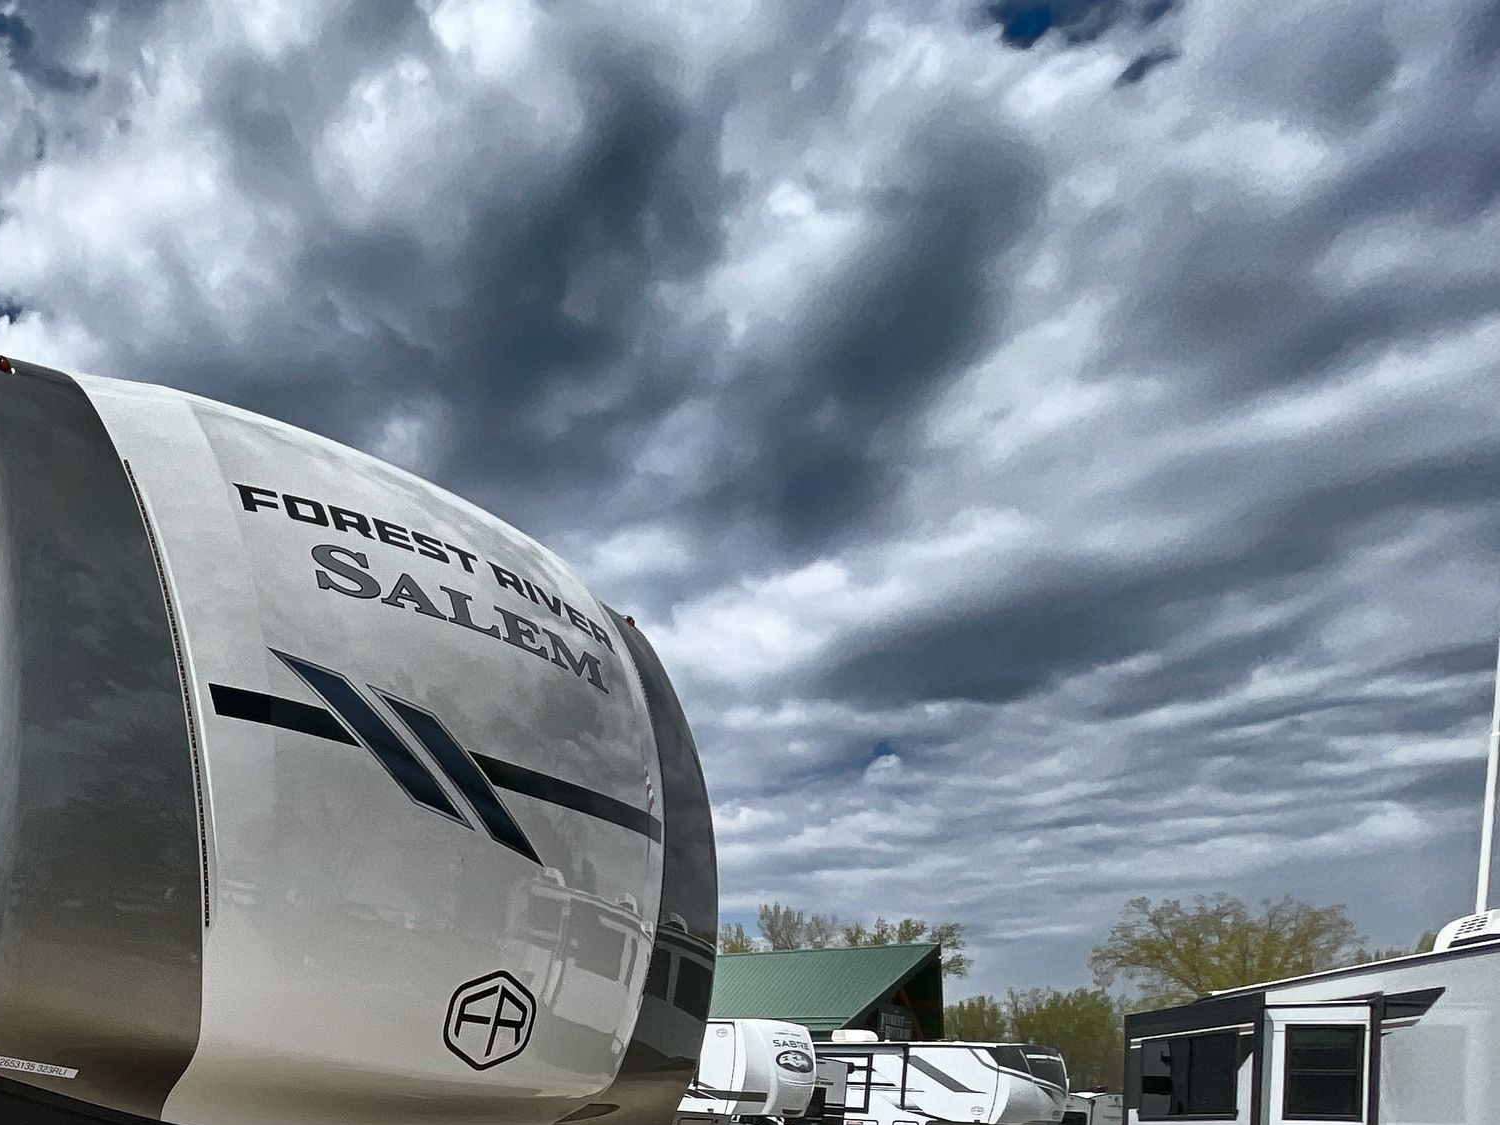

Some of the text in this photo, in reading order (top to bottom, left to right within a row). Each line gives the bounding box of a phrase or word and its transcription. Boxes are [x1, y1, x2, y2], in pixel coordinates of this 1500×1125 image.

[232, 482, 616, 655] FOREST RIVER
[311, 544, 610, 695] SALEM
[773, 1039, 810, 1050] SABRE
